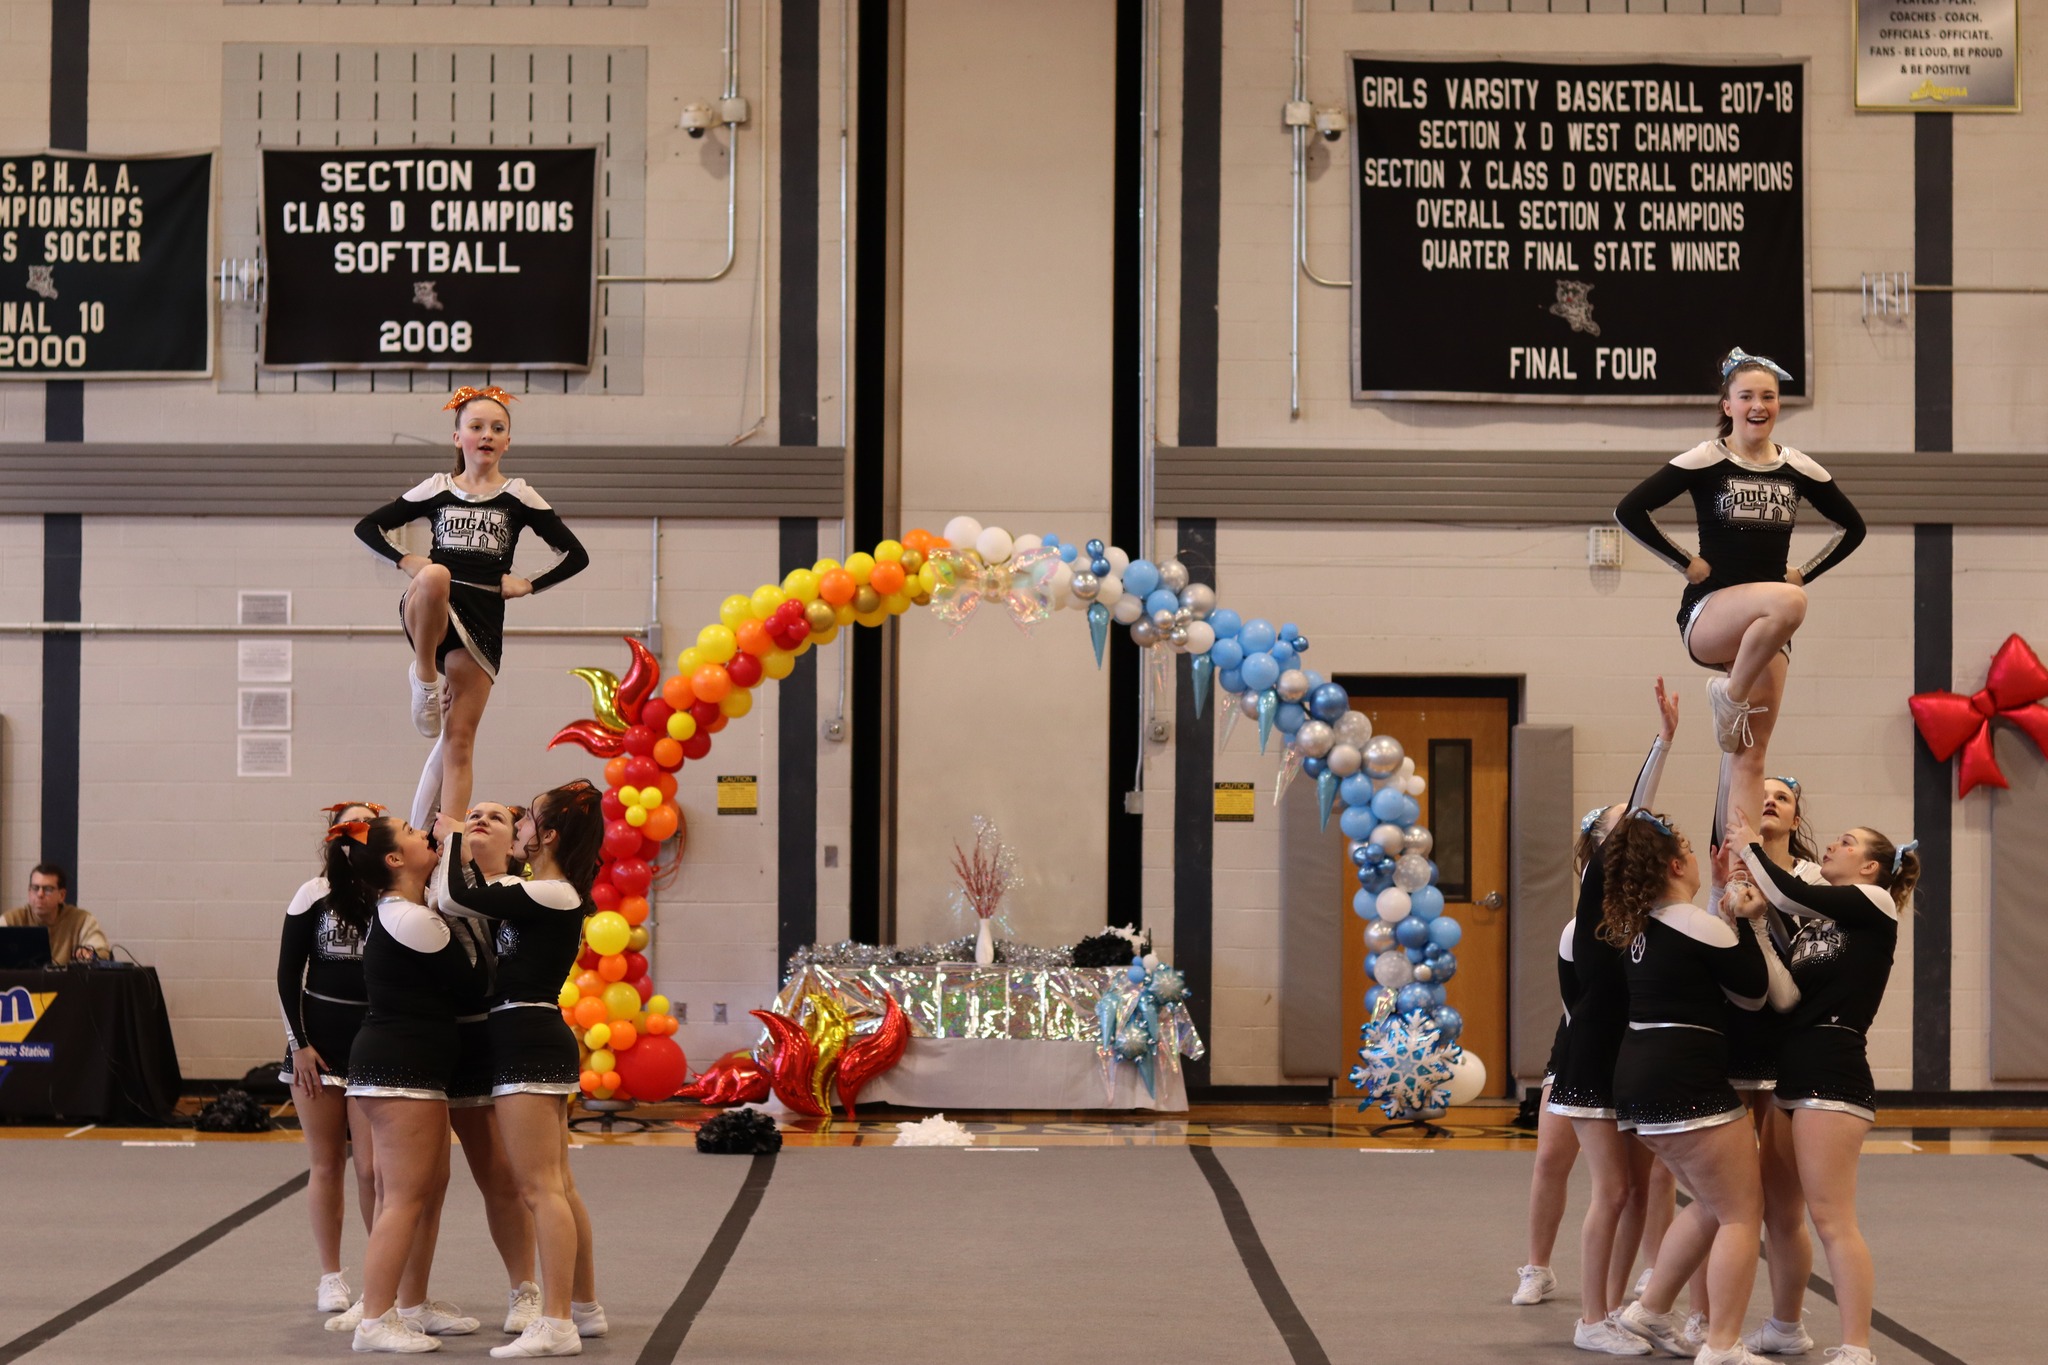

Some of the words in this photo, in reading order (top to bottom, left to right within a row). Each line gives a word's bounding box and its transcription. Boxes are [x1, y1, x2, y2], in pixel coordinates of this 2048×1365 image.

[1890, 11, 1936, 22] COACHES
[1945, 11, 1982, 22] COACH.
[1880, 29, 1931, 40] OFFICIALS
[1939, 29, 1993, 40] OFFICIATE.
[1870, 46, 1896, 57] FANS
[1904, 47, 1916, 57] BE
[1919, 47, 1950, 59] LOUD,
[1953, 47, 1965, 58] BE
[1968, 47, 2003, 58] PROUD
[1900, 64, 1907, 75] &
[1910, 64, 1923, 75] BE
[1926, 64, 1971, 75] POSITIVE
[1362, 76, 1427, 109] GIRLS
[1445, 78, 1539, 110] VARSITY
[1556, 80, 1704, 113] BASKETBALL
[1721, 81, 1793, 113] 2017-18
[1419, 119, 1500, 150] SECTION
[1514, 121, 1527, 150] X
[1540, 121, 1553, 151] D
[1567, 122, 1621, 152] WEST
[1635, 122, 1740, 152] CHAMPIONS
[320, 159, 473, 193] SECTION
[498, 160, 536, 192] 10
[1364, 158, 1445, 189] SECTION
[1459, 160, 1472, 189] X
[1486, 160, 1548, 191] CLASS
[1563, 161, 1576, 191] D
[1589, 162, 1677, 192] OVERALL
[1690, 161, 1793, 192] CHAMPIONS
[283, 201, 365, 234] CLASS
[390, 200, 405, 232] D
[430, 200, 573, 232] CHAMPIONS
[1416, 199, 1505, 229] OVERALL
[1519, 200, 1599, 231] SECTION
[1614, 201, 1627, 231] X
[1640, 201, 1745, 231] CHAMPIONS
[44, 230, 141, 263] SOCCER
[334, 241, 521, 274] SOFTBALL
[1422, 239, 1510, 271] QUARTER
[1524, 240, 1579, 271] FINAL
[1594, 241, 1656, 271] STATE
[1671, 241, 1740, 271] WINNER
[79, 301, 104, 333] 10
[0, 335, 86, 367] 2000
[379, 320, 472, 353] 2008
[1510, 347, 1578, 380] FINAL
[1596, 347, 1657, 380] FOUR
[1721, 489, 1798, 514] COUGARS
[435, 517, 509, 545] COUGARS
[19, 1044, 51, 1058] Station
